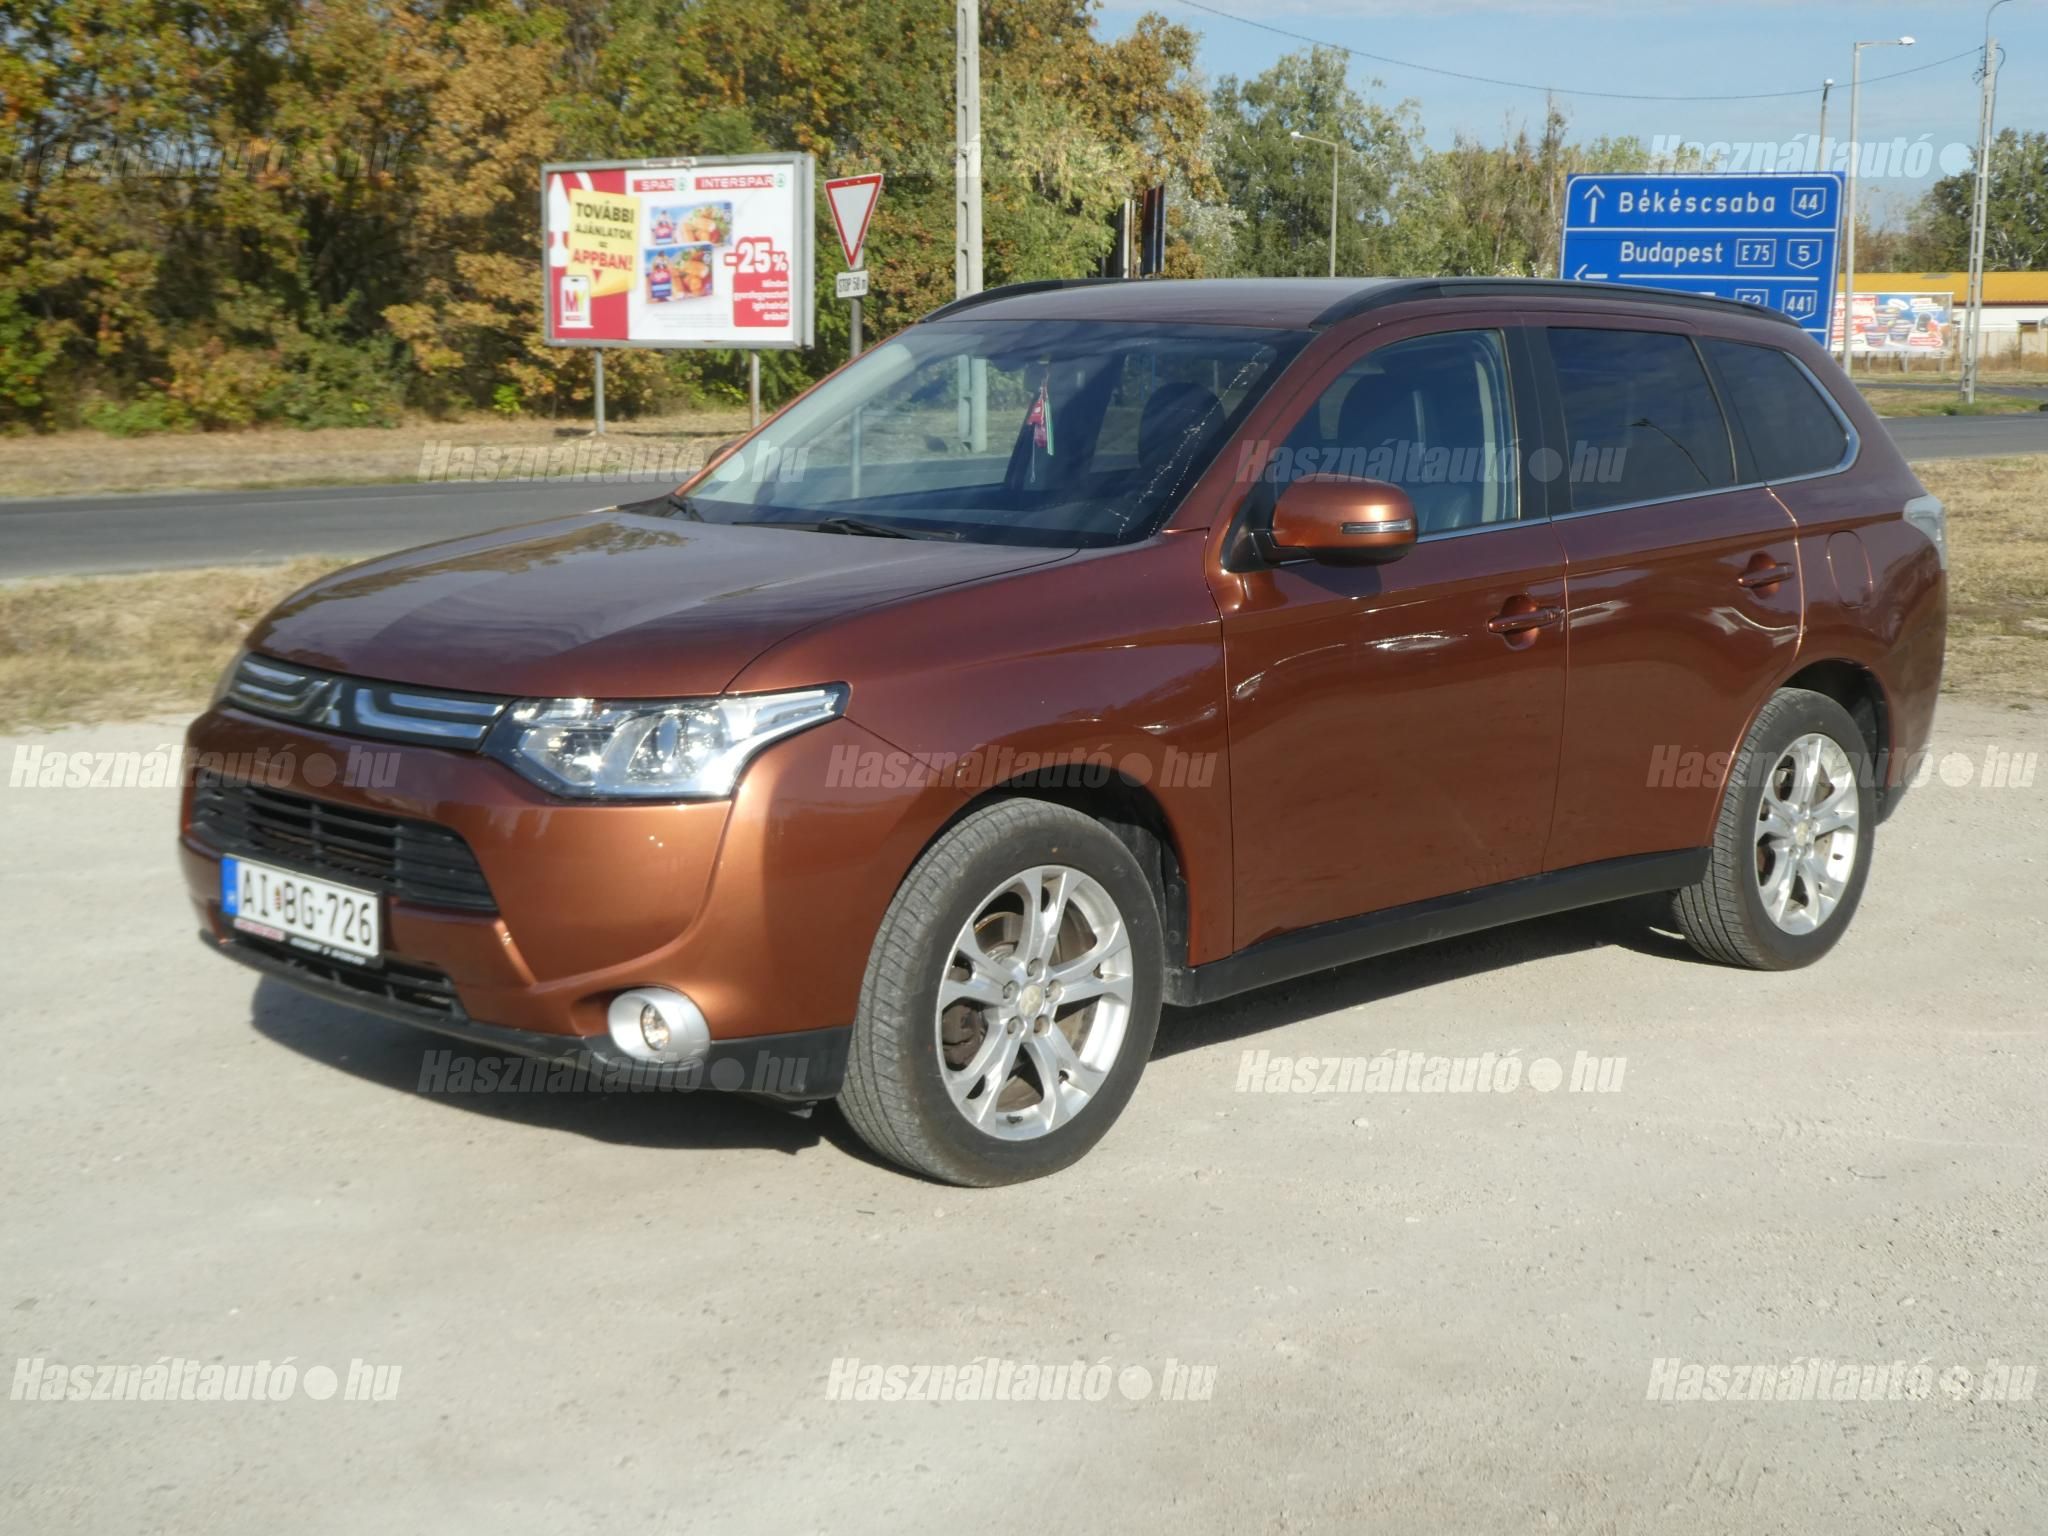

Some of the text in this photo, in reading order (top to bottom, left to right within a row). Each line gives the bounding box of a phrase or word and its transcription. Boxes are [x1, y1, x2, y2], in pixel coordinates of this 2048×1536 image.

[641, 179, 675, 191] SPAR
[701, 174, 774, 189] INTERSPAR
[1619, 188, 1818, 213] Békéscsaba 44
[575, 200, 635, 224] TOVÁBBI
[575, 221, 633, 241] AJÁNLATOK
[572, 248, 633, 272] APPBAN!
[1620, 241, 1723, 268] Budapest
[1797, 244, 1810, 262] 5
[1786, 295, 1812, 312] 441
